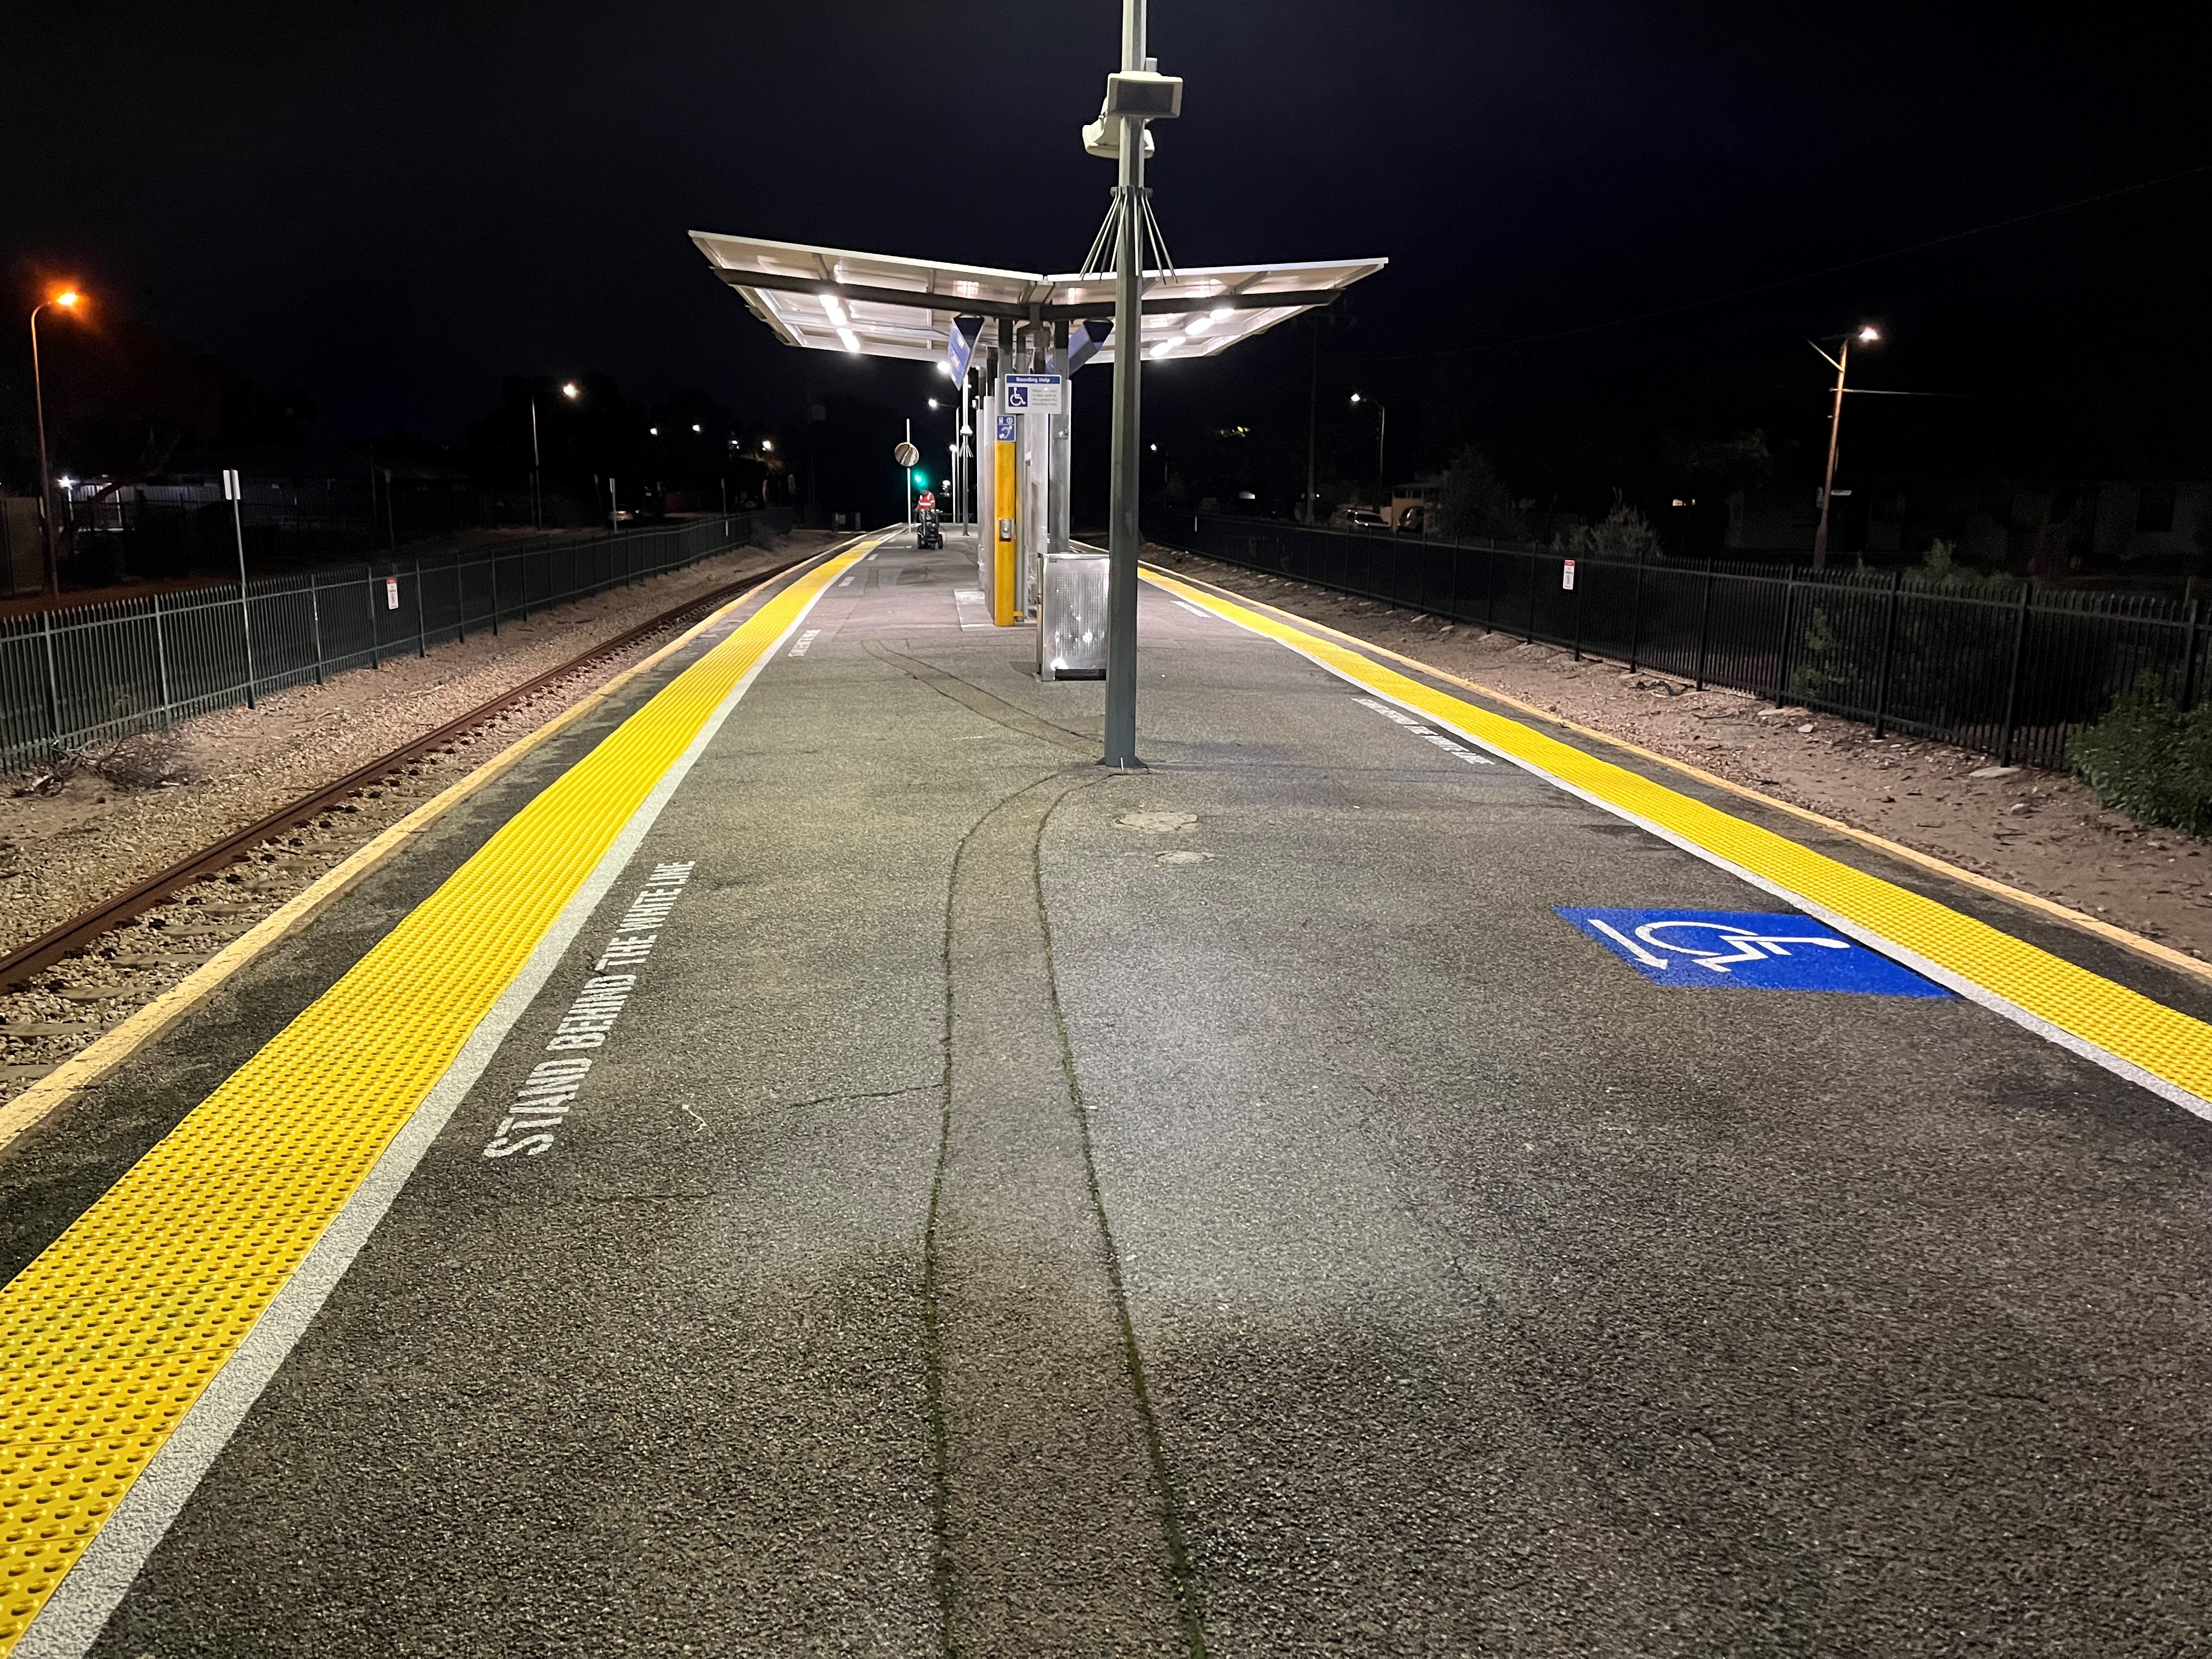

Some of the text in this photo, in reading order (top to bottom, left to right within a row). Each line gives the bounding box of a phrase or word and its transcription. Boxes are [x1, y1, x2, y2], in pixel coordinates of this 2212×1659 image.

[483, 861, 696, 1158] STAND BEHIND THE WHITE LINE
